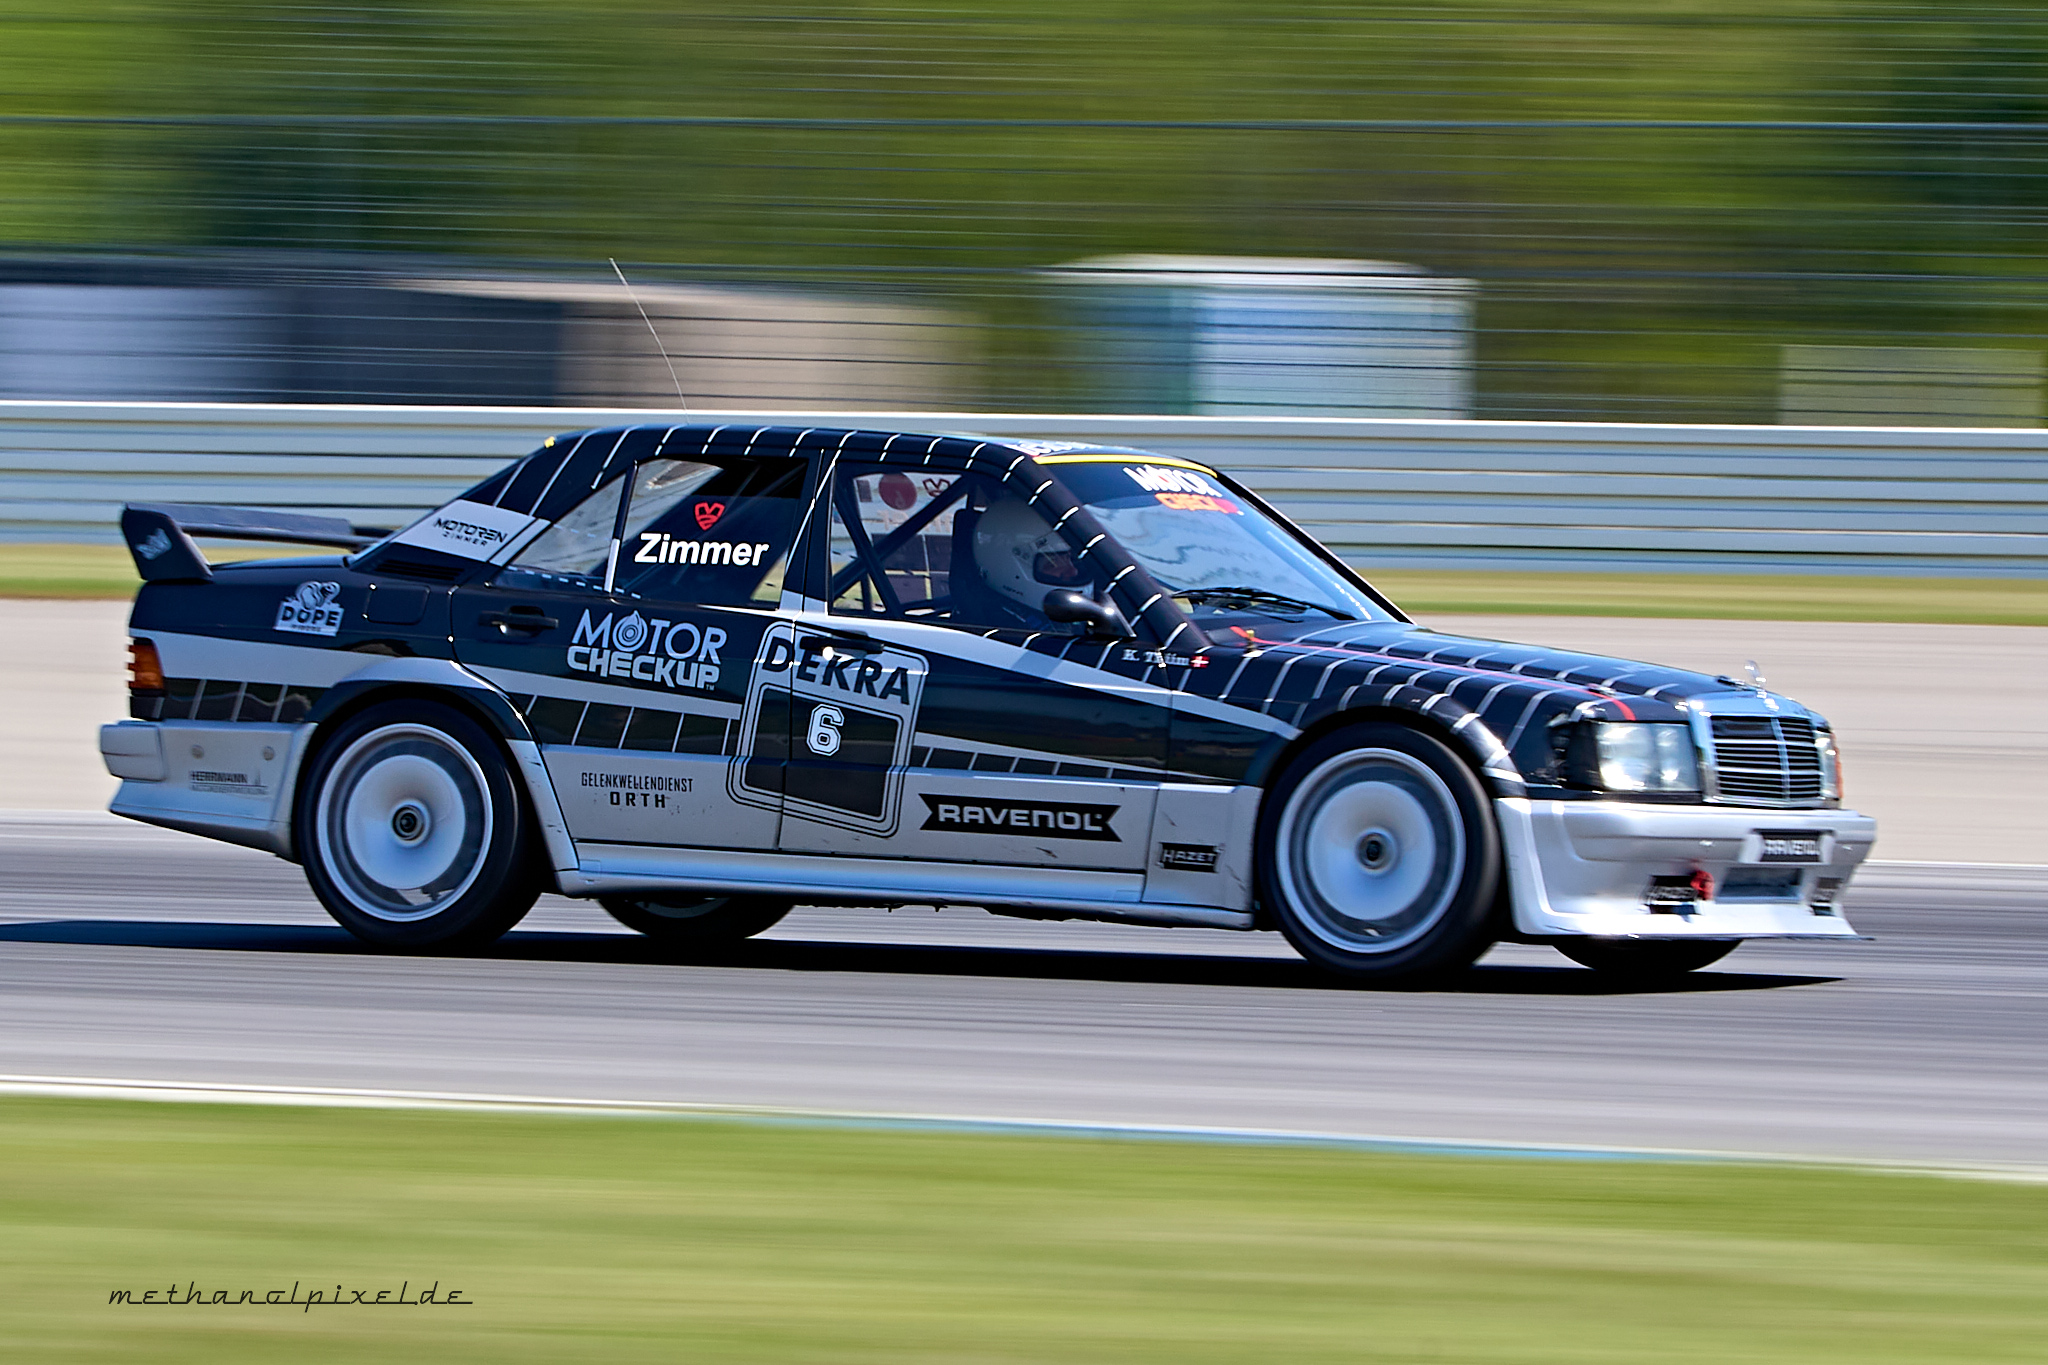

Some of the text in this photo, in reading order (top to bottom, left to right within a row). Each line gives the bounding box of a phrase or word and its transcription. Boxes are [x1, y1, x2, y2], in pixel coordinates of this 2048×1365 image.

[1123, 464, 1222, 497] MOTOR
[434, 517, 508, 543] MOTOREN
[634, 533, 770, 566] Zimmer
[281, 606, 339, 626] DOPE
[572, 608, 728, 665] MOTOR
[567, 646, 720, 689] CHECKUP
[762, 636, 910, 705] DEKRA
[806, 703, 845, 757] 6
[581, 772, 693, 792] GELENKWELLENDIENST
[610, 791, 666, 808] ORTH
[938, 804, 1103, 831] RAVENOL
[1163, 849, 1217, 863] HAZET
